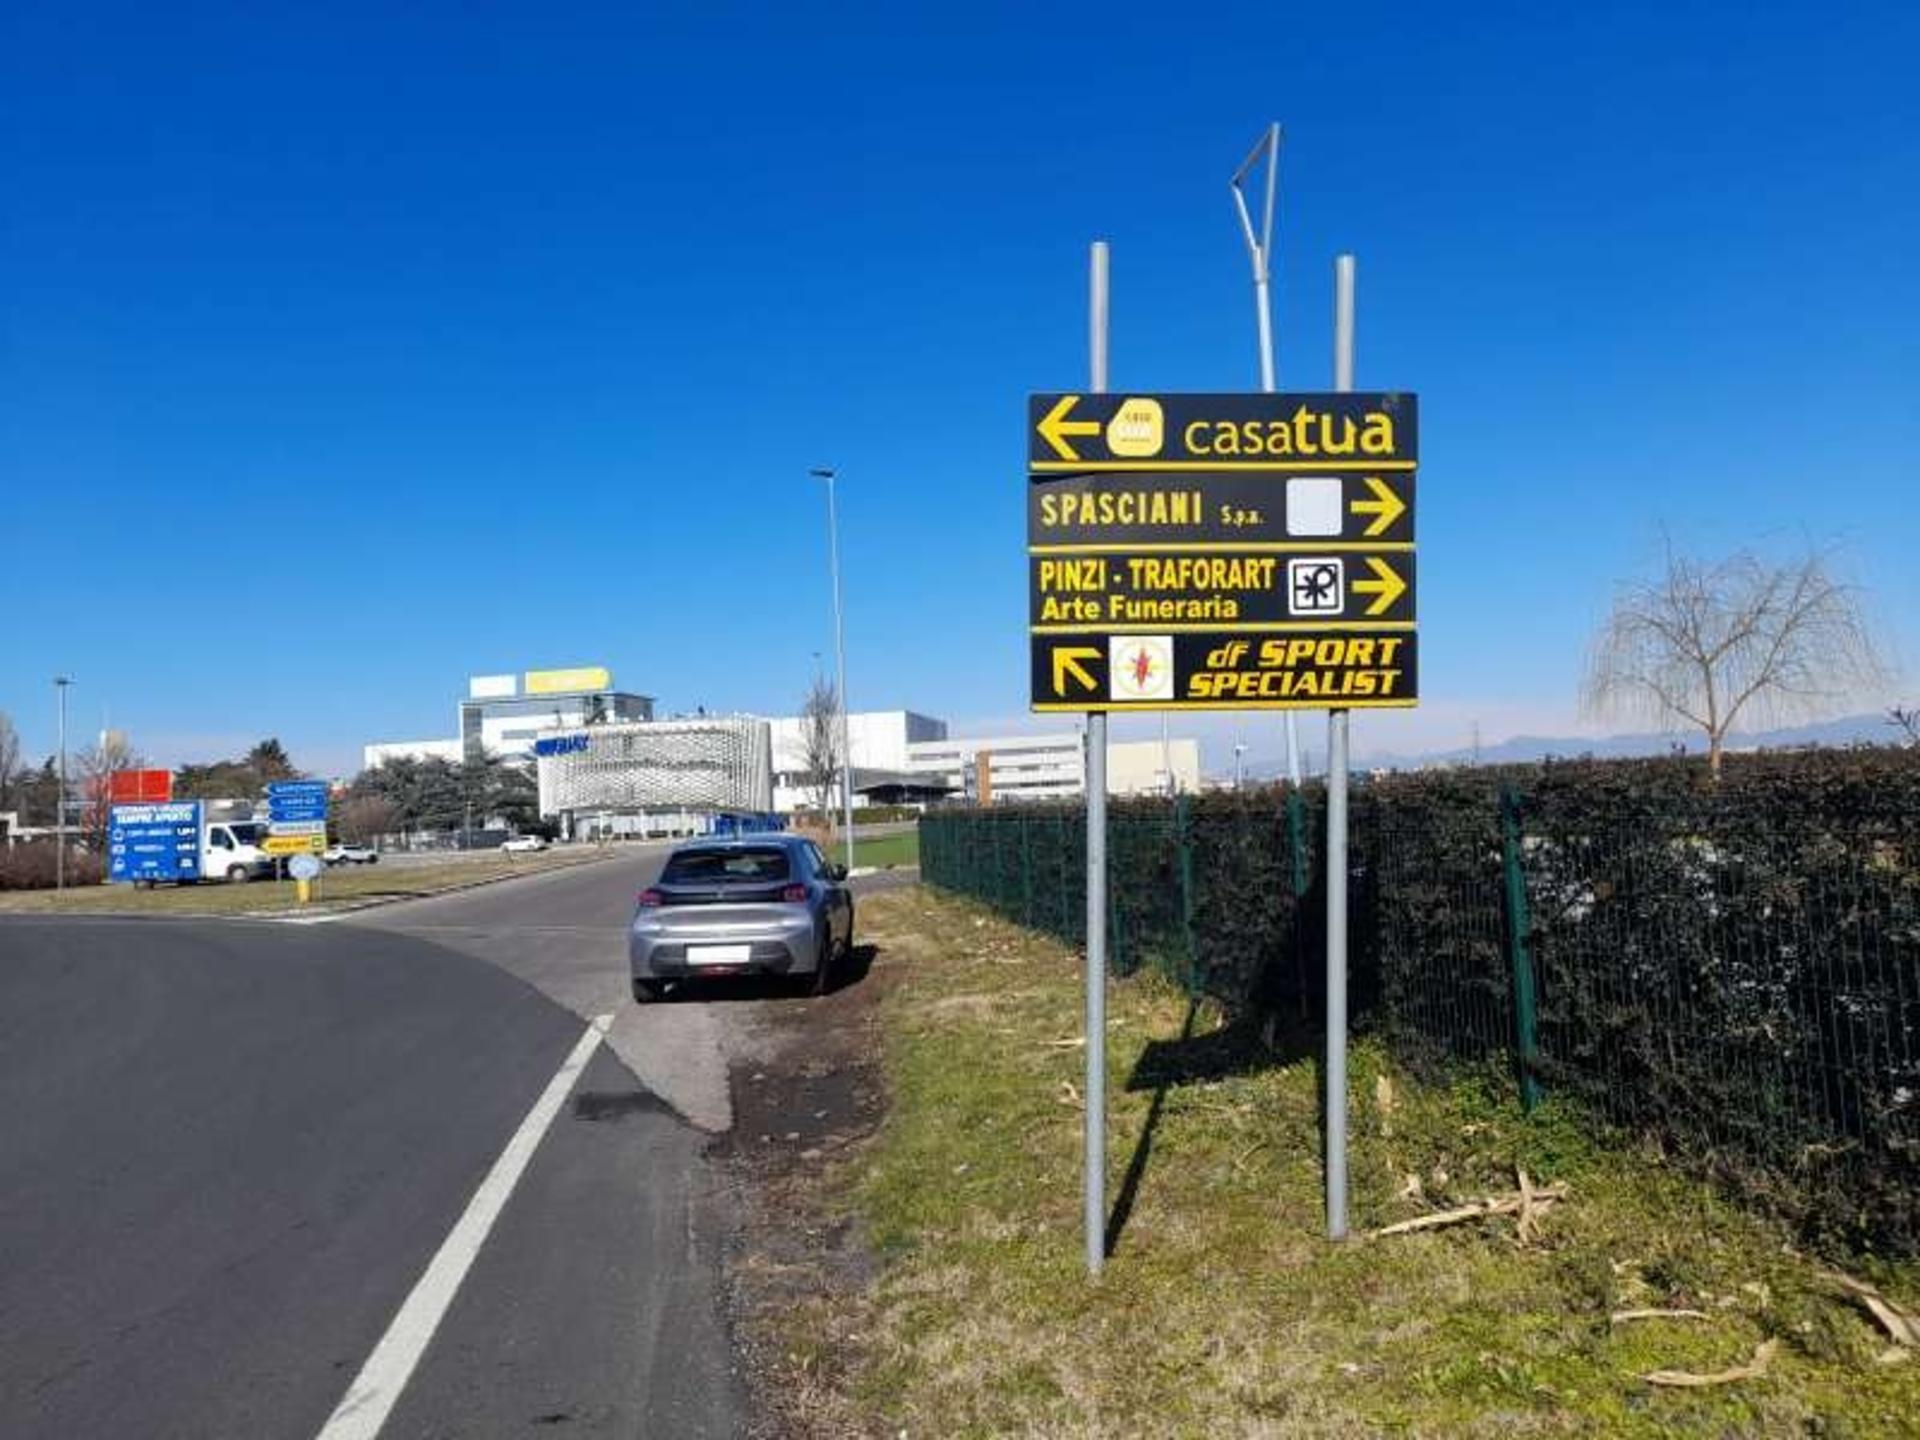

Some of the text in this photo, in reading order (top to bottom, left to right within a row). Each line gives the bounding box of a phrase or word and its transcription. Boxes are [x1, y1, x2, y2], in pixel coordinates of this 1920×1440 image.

[1184, 404, 1396, 455] casatua
[1040, 491, 1202, 527] SPASCIANI
[1040, 559, 1106, 592] PINZI
[1128, 558, 1276, 591] TRAFORART
[1041, 594, 1239, 621] Arte Funeraria
[1258, 637, 1403, 667] SPORT
[1188, 668, 1402, 698] SPECIALIST
